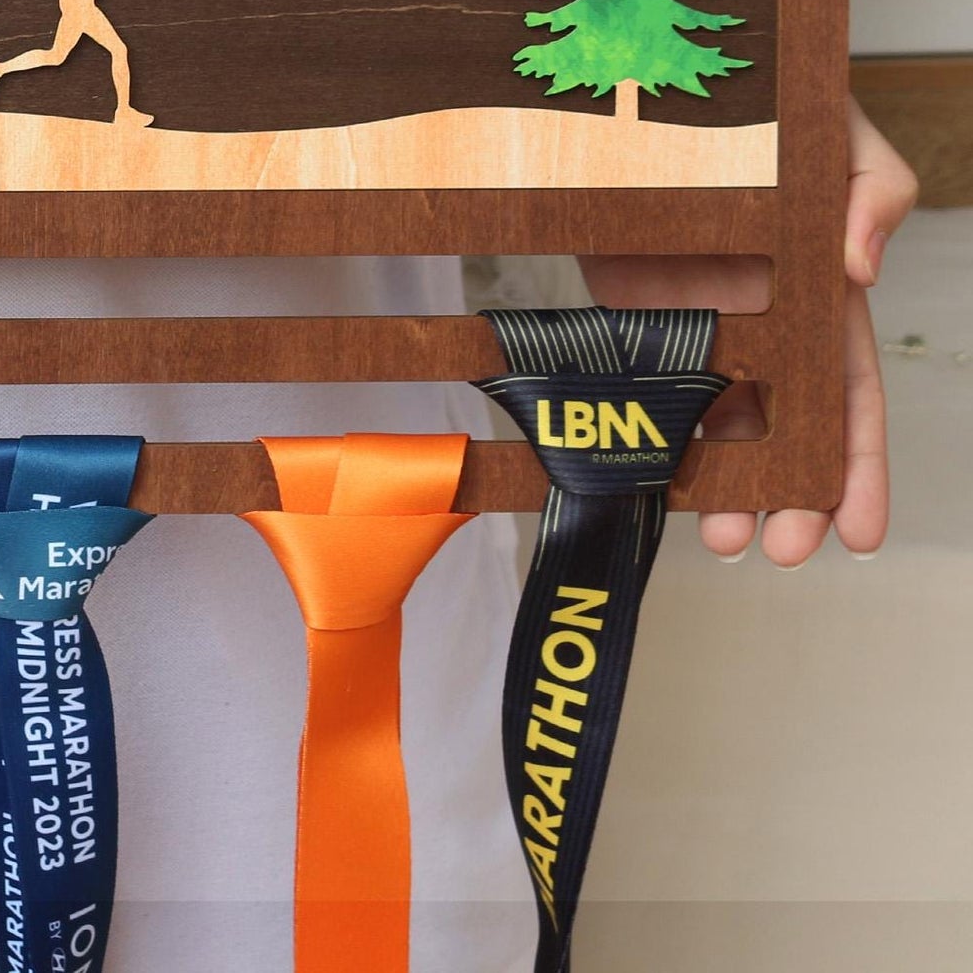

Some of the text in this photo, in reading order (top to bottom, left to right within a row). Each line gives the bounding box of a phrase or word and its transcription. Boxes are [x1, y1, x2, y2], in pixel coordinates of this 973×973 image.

[536, 398, 669, 450] LBM
[47, 541, 122, 570] Expr
[17, 575, 101, 601] Mara
[15, 620, 66, 872] MIDNIGHT 2023
[57, 688, 96, 865] MARATHON
